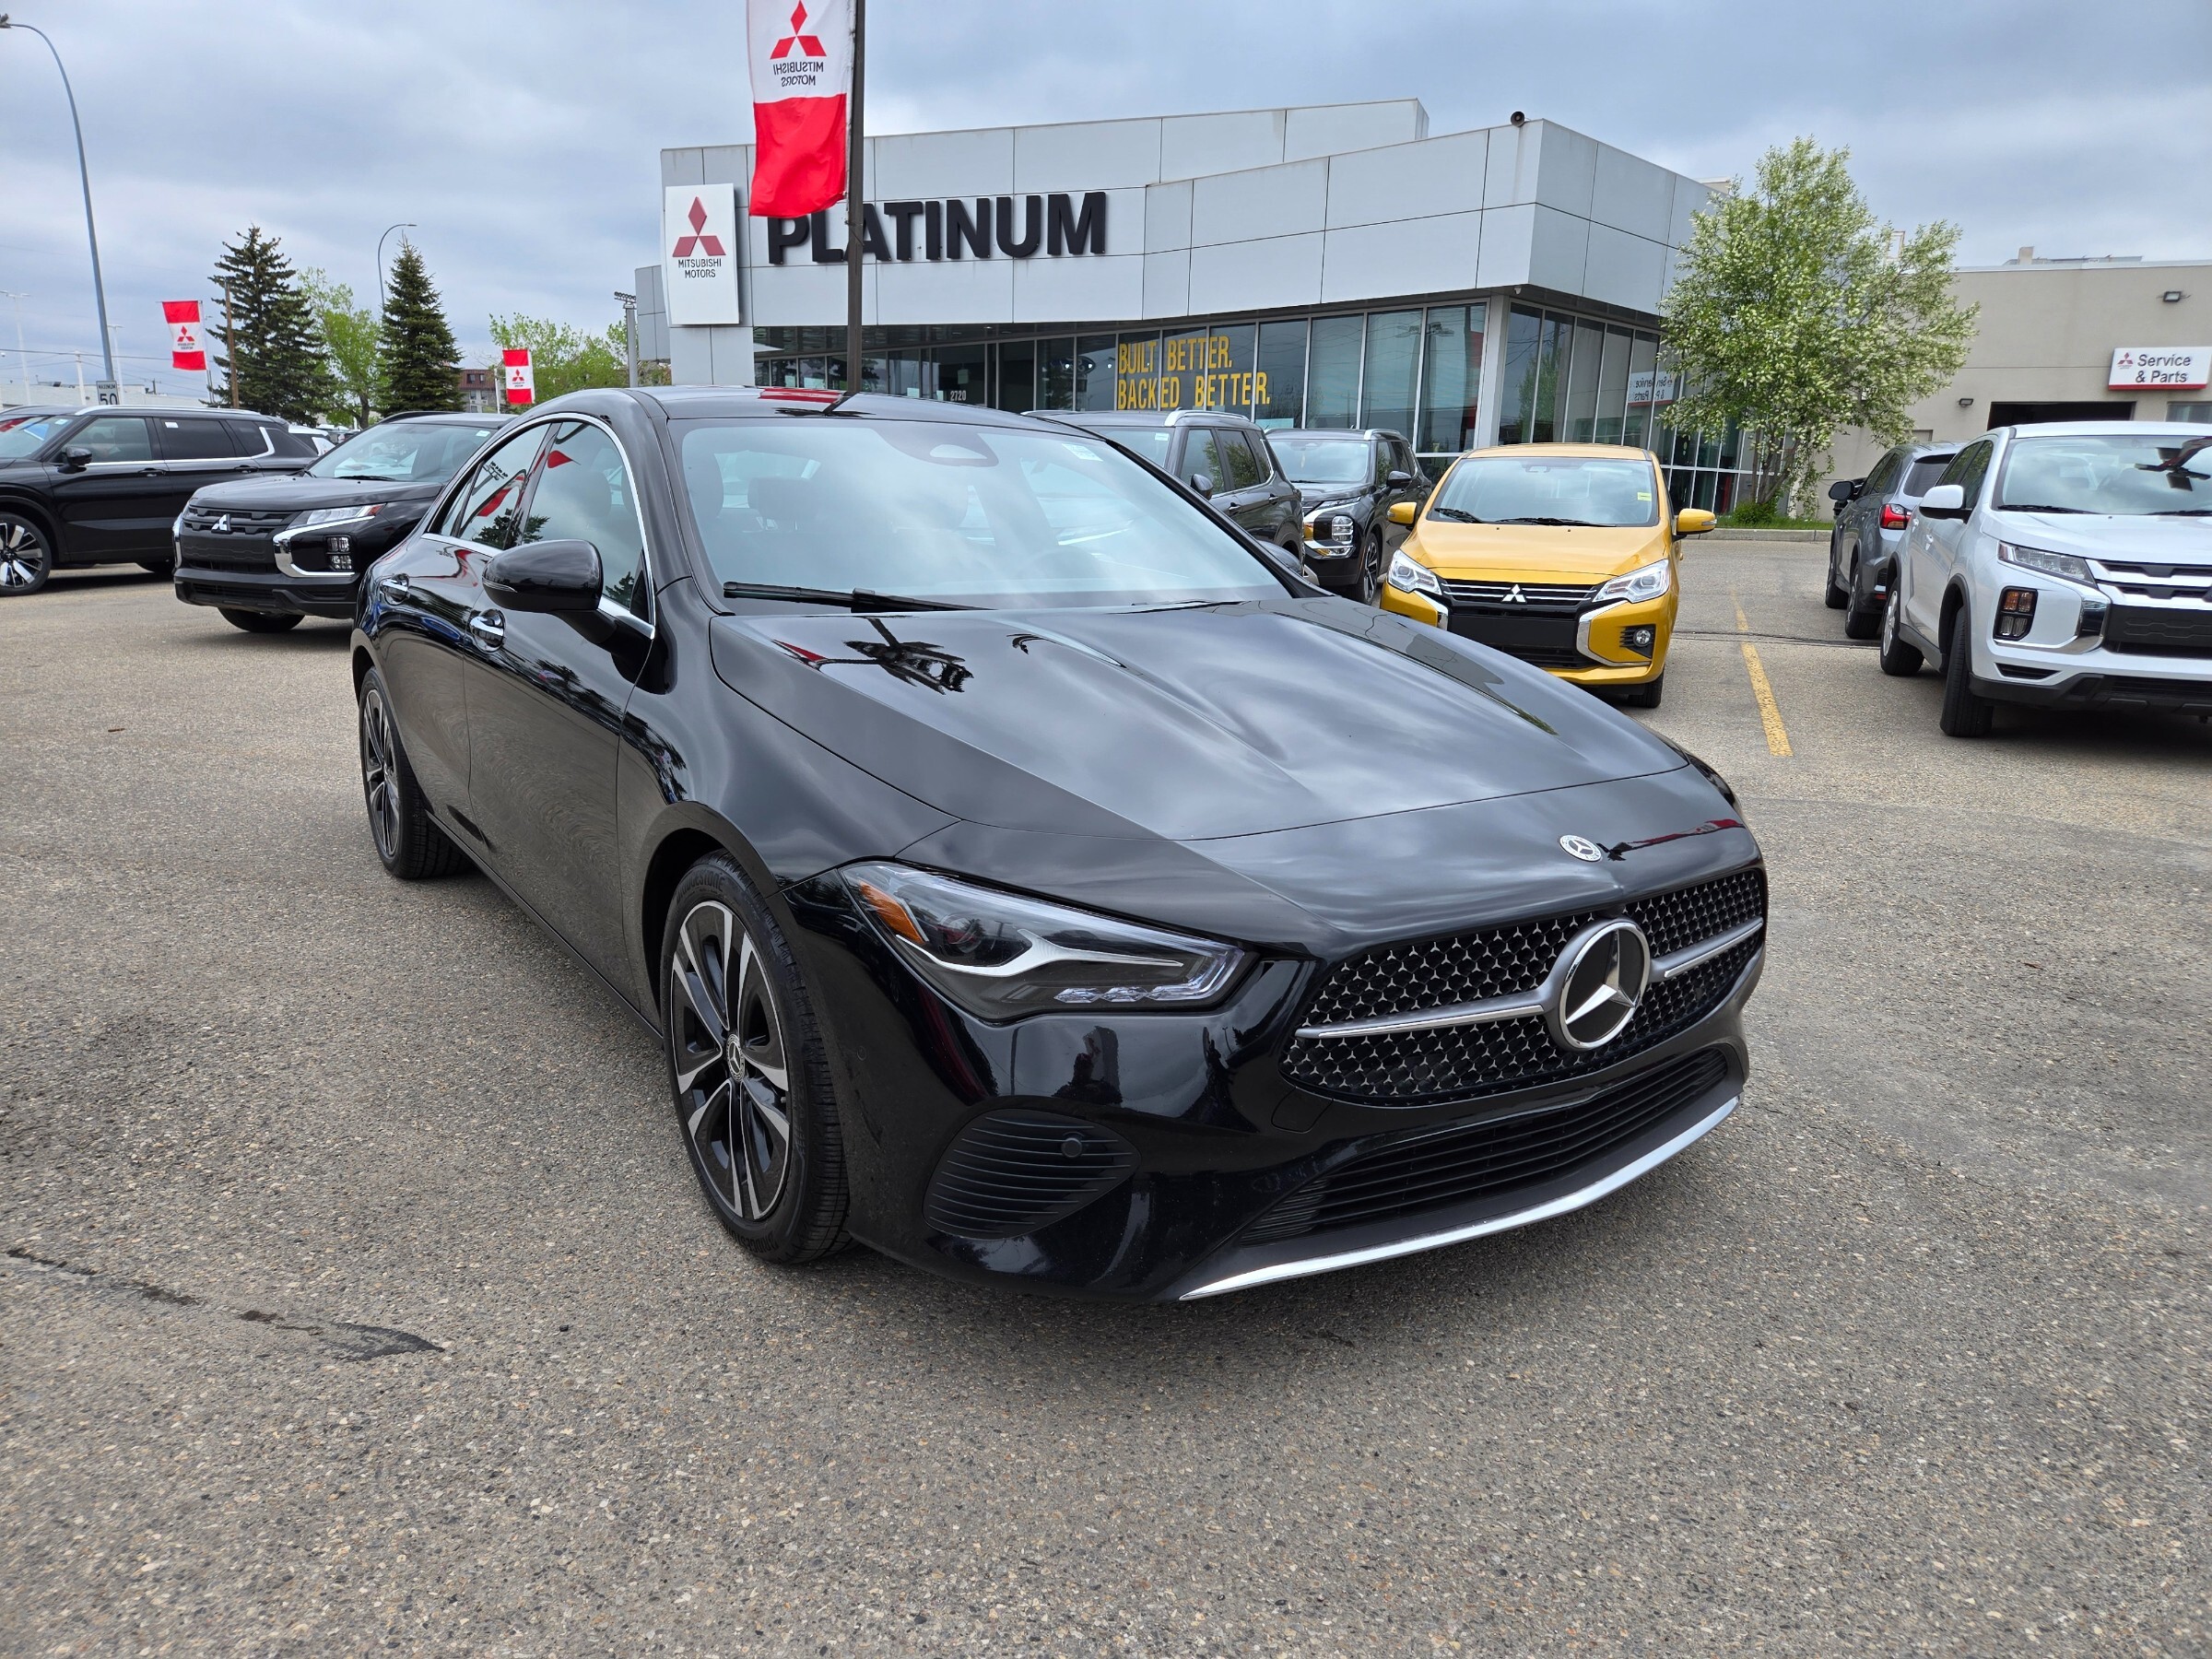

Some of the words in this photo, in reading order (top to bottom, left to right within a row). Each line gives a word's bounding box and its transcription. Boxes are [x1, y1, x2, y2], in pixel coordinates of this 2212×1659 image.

[767, 192, 1107, 265] PLATINUM
[677, 258, 722, 268] MITSUBISHI
[685, 268, 716, 278] MOTORS
[1118, 341, 1158, 374] BUILT
[1167, 335, 1233, 371] BETTER.
[2137, 354, 2192, 367] Service
[2136, 370, 2146, 382] &
[2150, 370, 2188, 382] Parts
[950, 390, 967, 401] 2720
[1118, 376, 1181, 410] BACKED
[1194, 371, 1271, 407] BETTER.
[100, 393, 118, 405] 50
